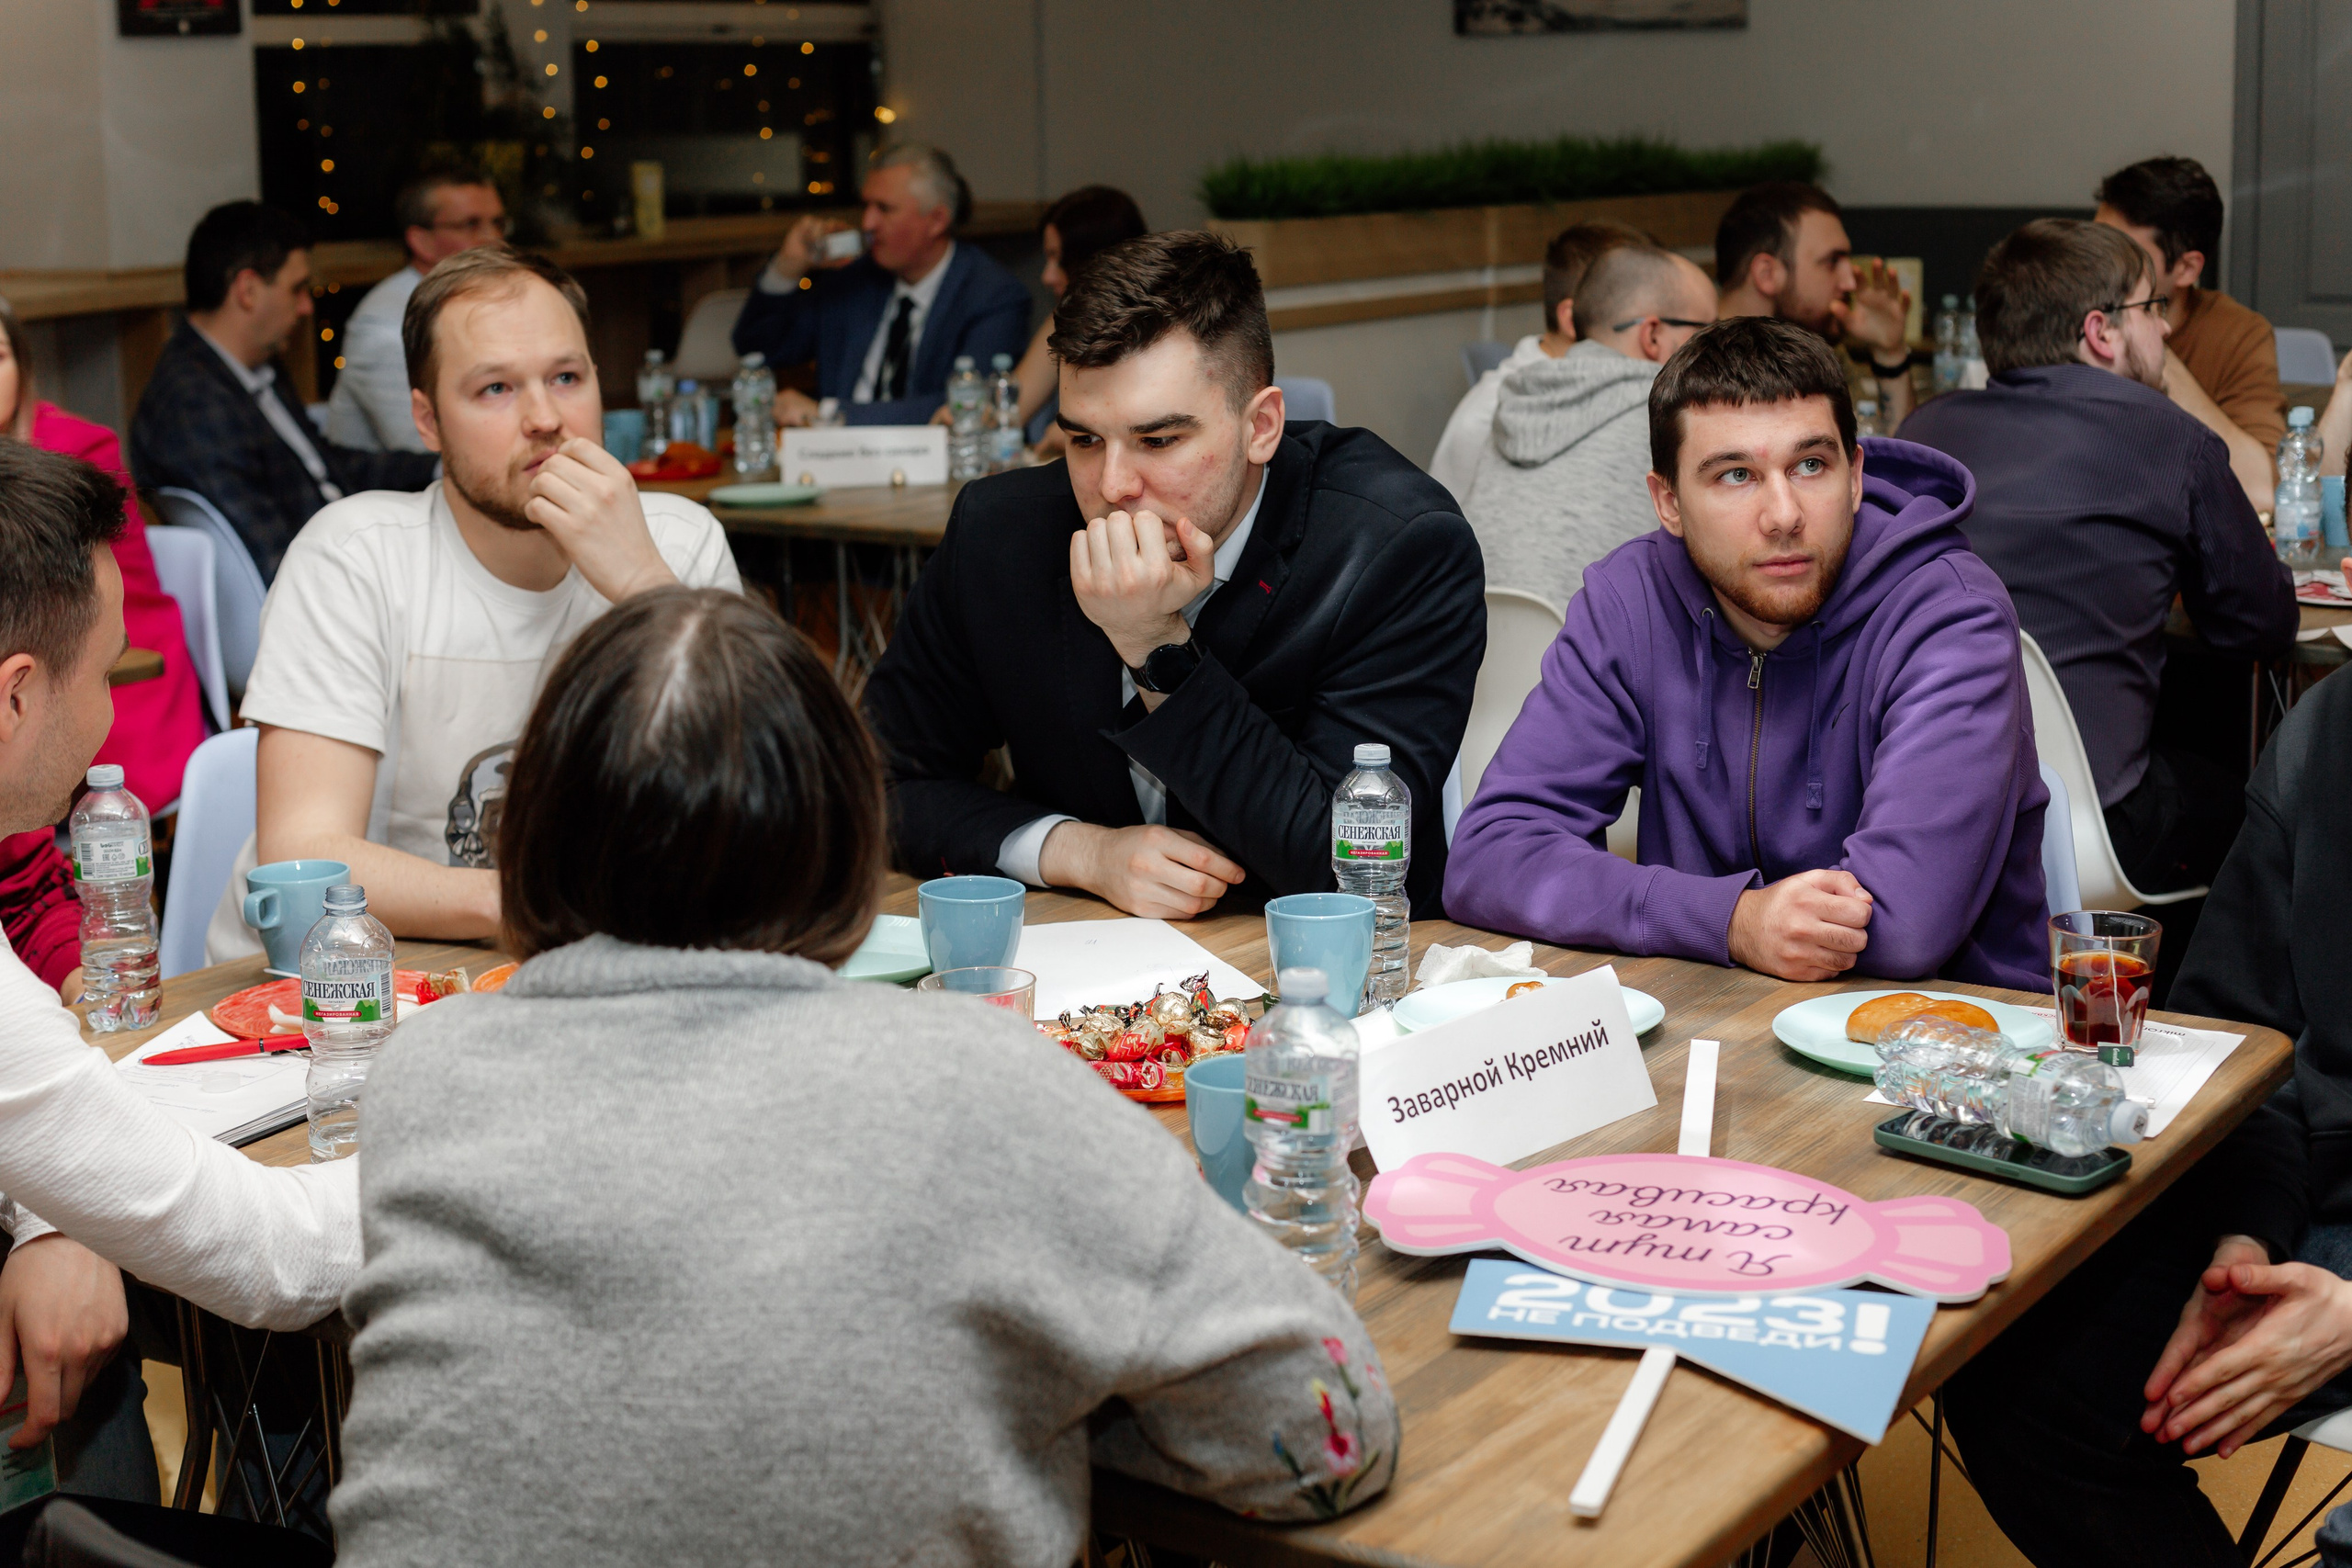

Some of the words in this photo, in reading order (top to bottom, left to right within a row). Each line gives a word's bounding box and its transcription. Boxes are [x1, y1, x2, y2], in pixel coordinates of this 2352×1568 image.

[1338, 824, 1401, 840] СЕНЕЖСКАЯ
[303, 980, 376, 998] СЕНЕЖСКАЯ
[1387, 1057, 1503, 1123] Заварной
[1504, 1019, 1610, 1081] Кремний
[1544, 1178, 1849, 1225] красивая
[1589, 1210, 1793, 1239] самая
[1559, 1234, 1713, 1262] тут
[1725, 1250, 1792, 1276] Я
[1487, 1305, 1557, 1325] НЕ
[1572, 1312, 1842, 1350] ПОДВЕДИ
[1496, 1274, 1891, 1355] 2023!
